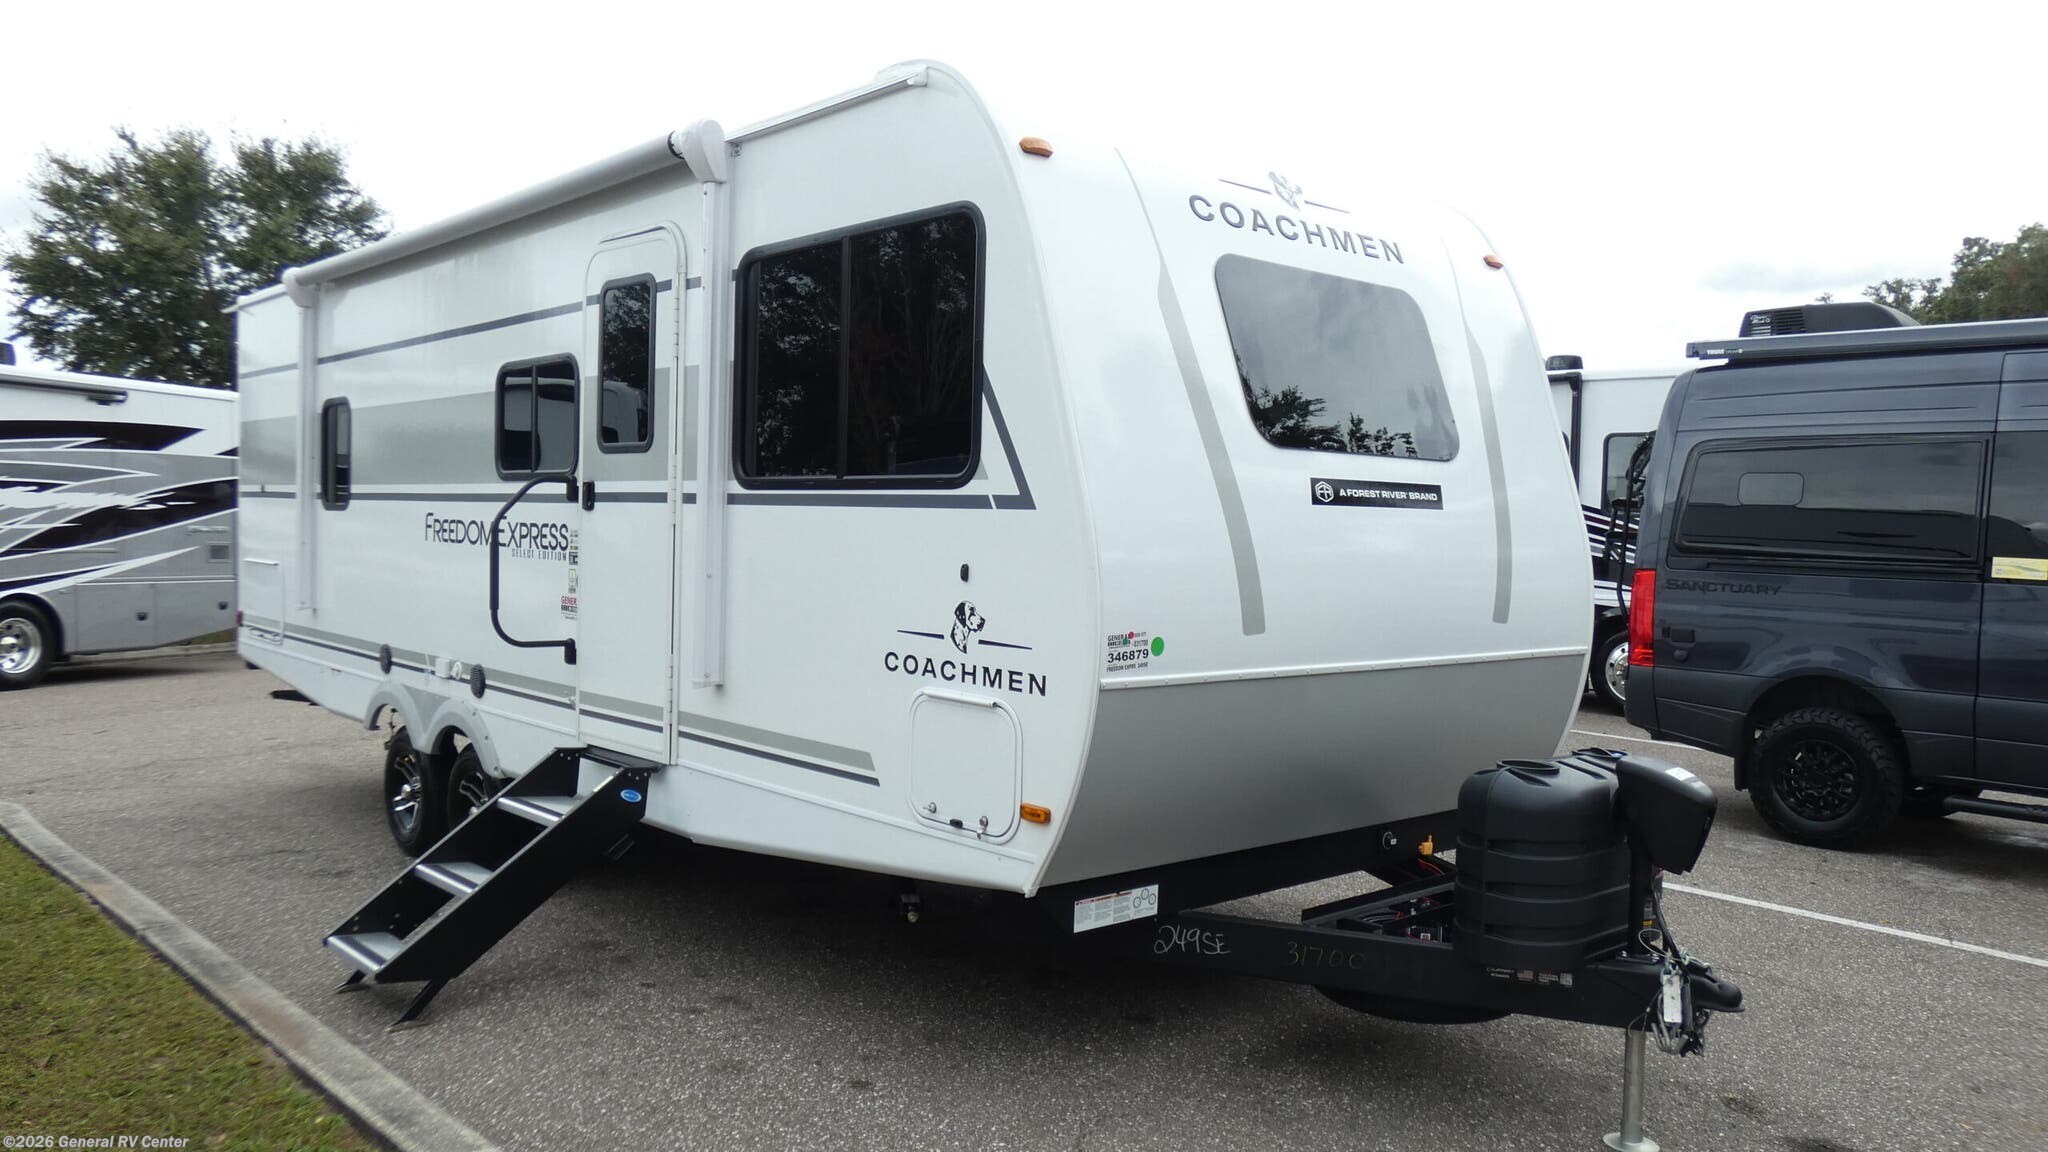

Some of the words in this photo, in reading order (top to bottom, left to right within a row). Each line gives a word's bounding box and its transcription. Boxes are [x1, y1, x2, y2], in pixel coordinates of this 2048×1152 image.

[1189, 194, 1404, 264] COACHMEN
[1339, 489, 1347, 497] A
[1348, 488, 1380, 498] FOREST
[1407, 492, 1438, 501] BRAND
[511, 549, 534, 559] SELECT
[538, 550, 568, 561] EDITION
[1665, 578, 1782, 595] SANCTUARY
[1107, 648, 1149, 664] 346879
[884, 651, 1047, 697] COACHMEN
[1154, 924, 1231, 955] 249SE
